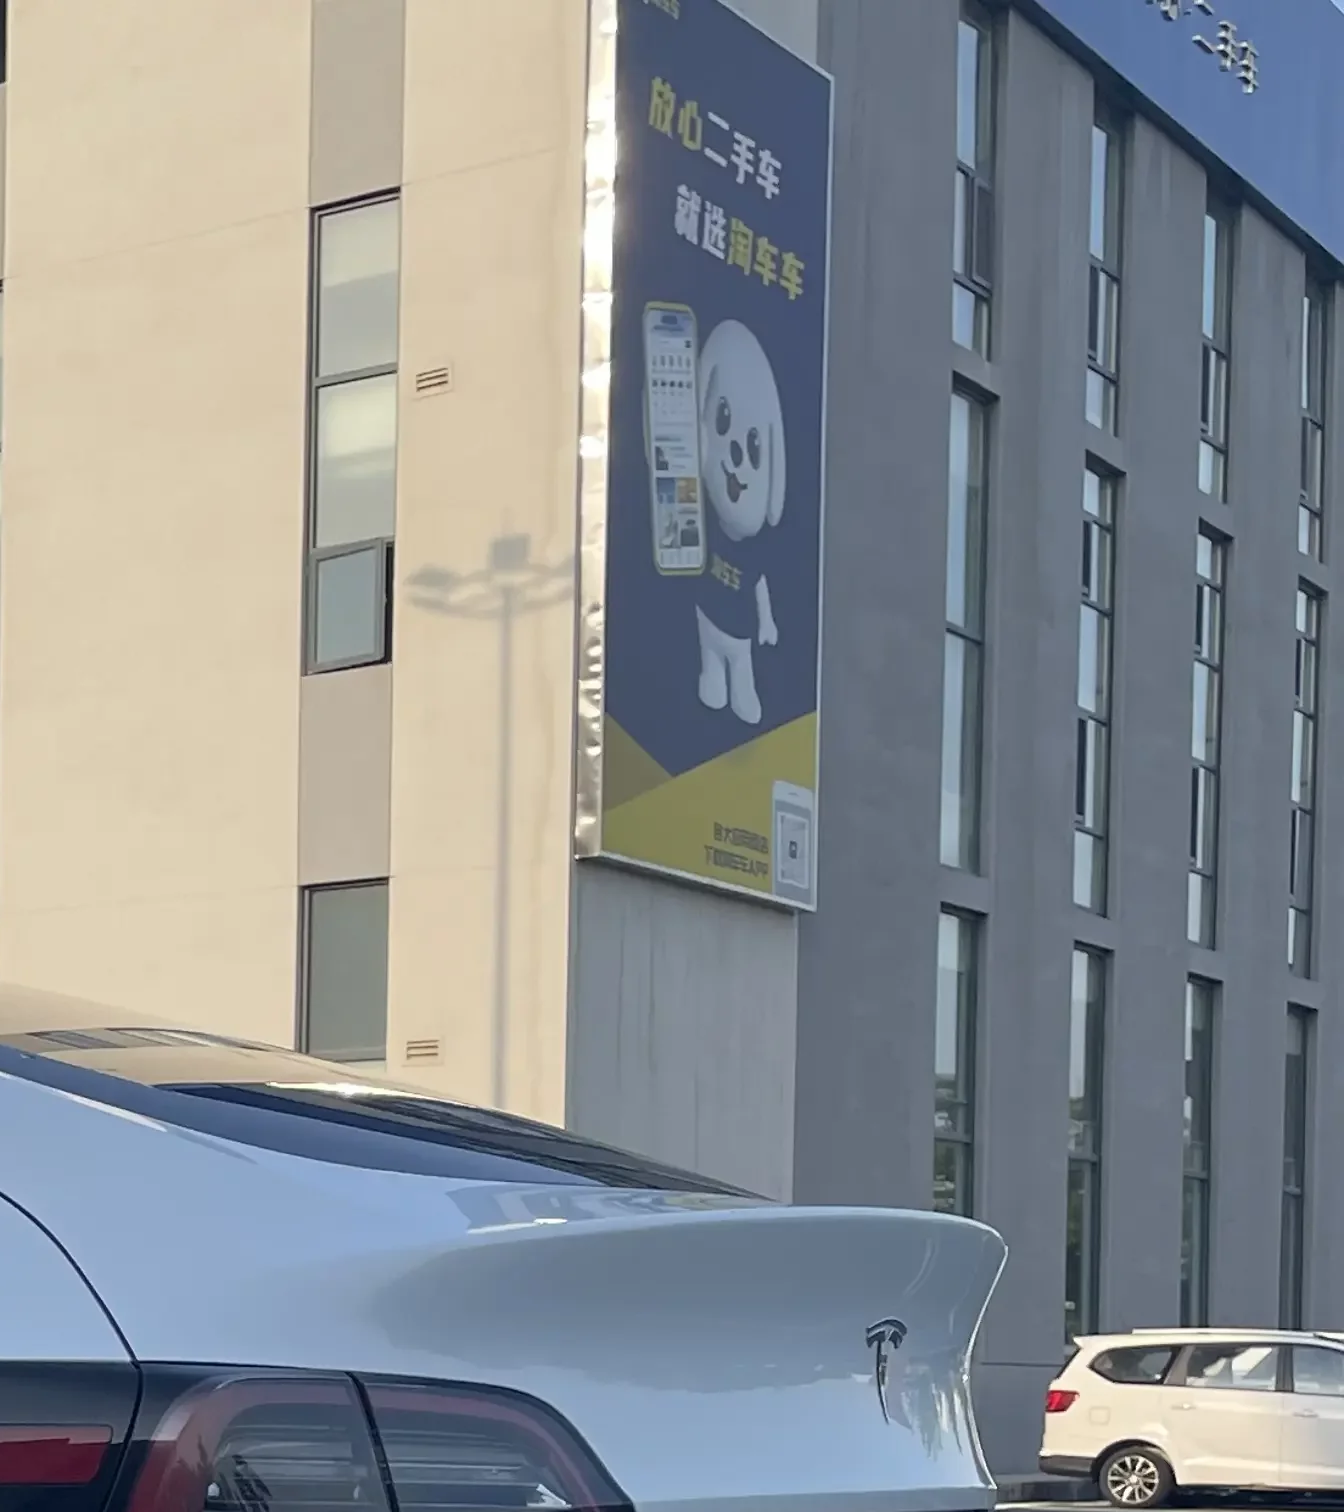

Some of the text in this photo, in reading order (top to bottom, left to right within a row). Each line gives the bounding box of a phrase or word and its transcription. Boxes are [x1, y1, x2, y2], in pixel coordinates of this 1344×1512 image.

[648, 76, 782, 199] 放心二手车
